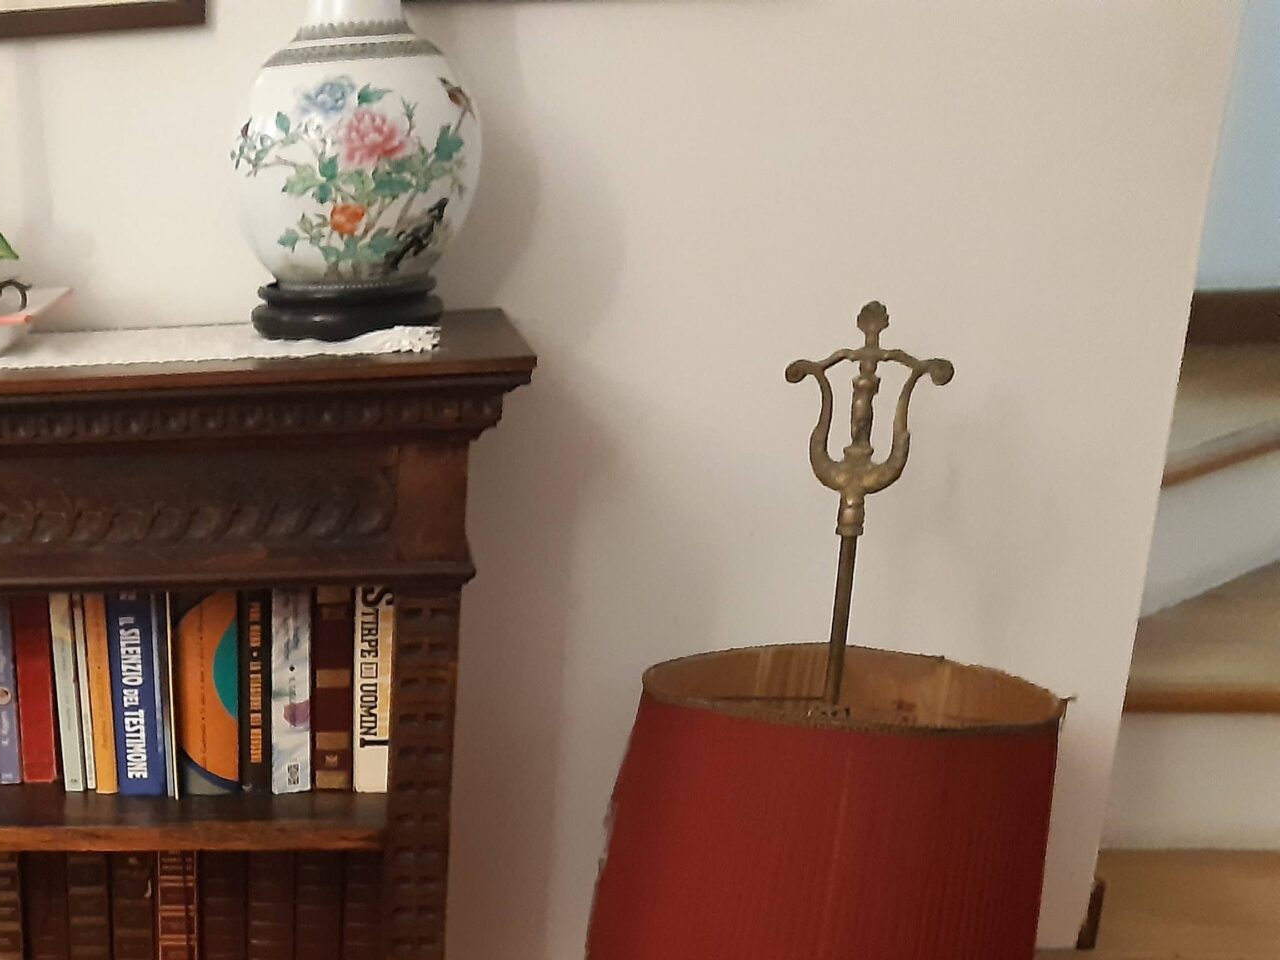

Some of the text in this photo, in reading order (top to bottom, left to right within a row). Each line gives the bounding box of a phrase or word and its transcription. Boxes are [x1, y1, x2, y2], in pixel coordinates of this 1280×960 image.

[118, 615, 131, 627] IL
[360, 585, 395, 659] STIRPE
[118, 627, 144, 688] SILENZIO
[122, 689, 139, 708] DEL
[359, 681, 390, 749] UOMINI
[123, 709, 149, 781] TESTIMONE
